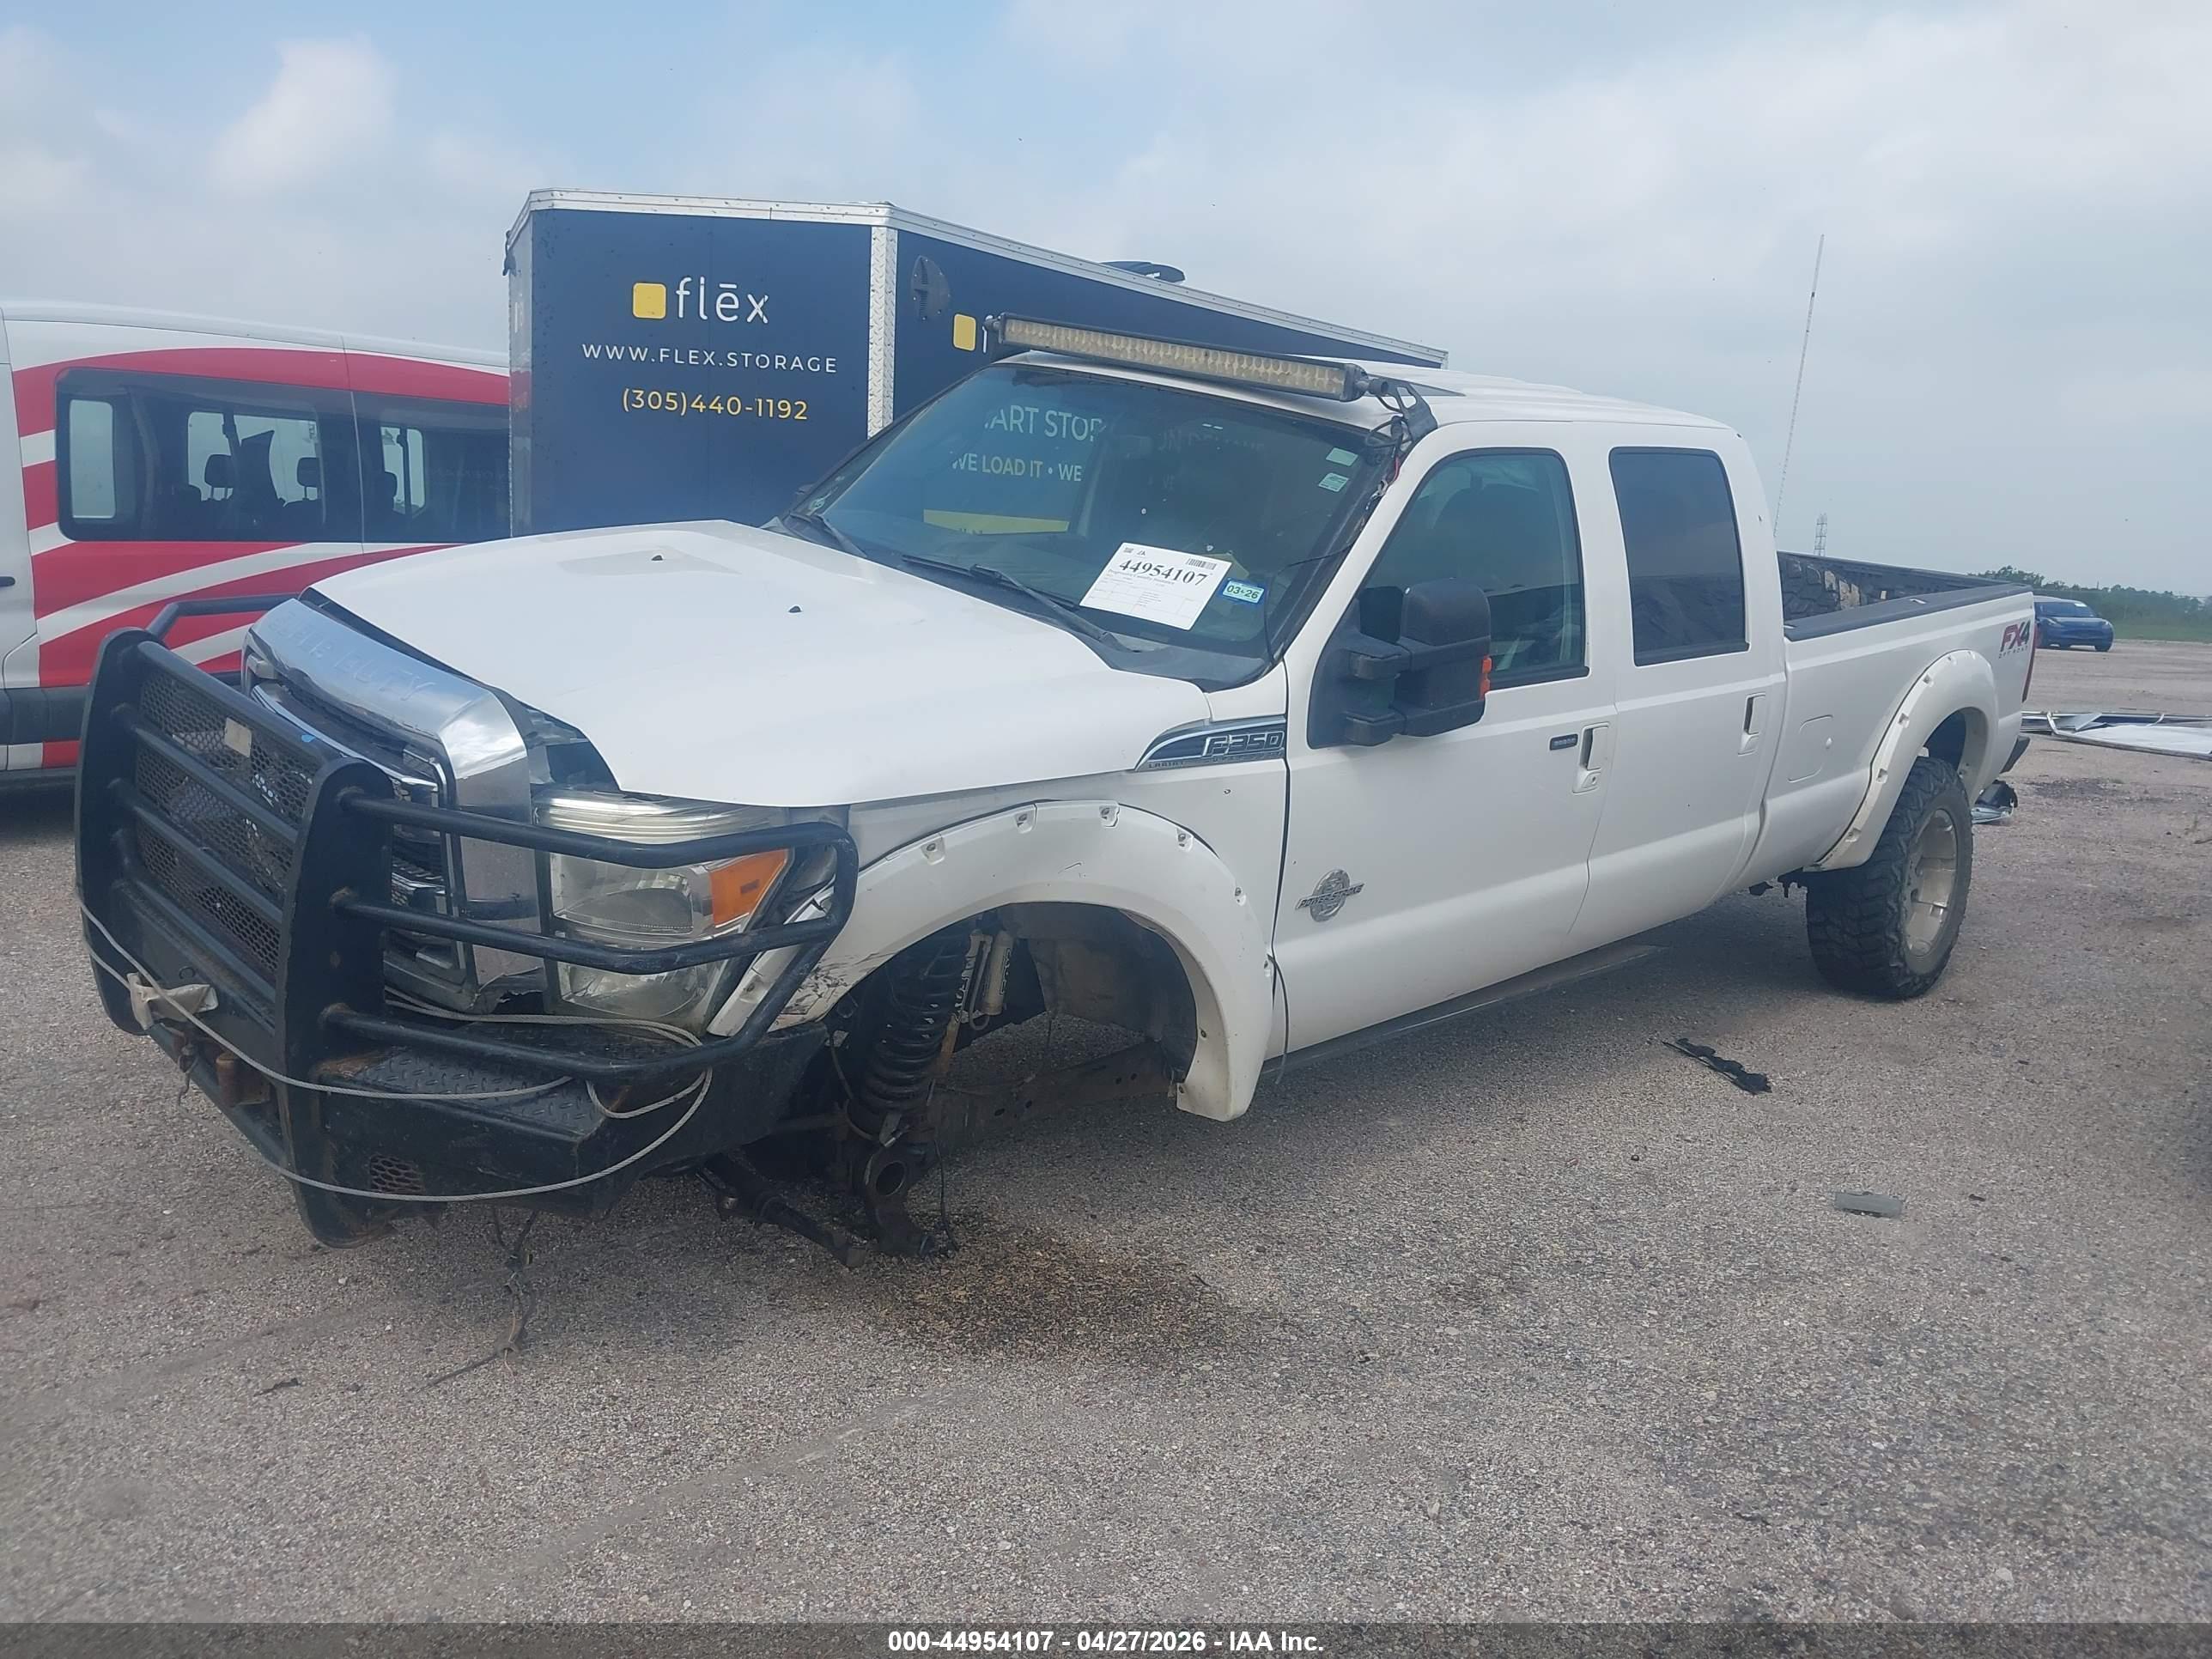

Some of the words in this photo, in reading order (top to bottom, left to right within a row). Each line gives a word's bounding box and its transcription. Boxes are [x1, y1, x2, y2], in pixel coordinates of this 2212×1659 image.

[675, 276, 769, 325] flēx
[581, 343, 838, 374] WWW.FLEX.STORAGE
[622, 388, 809, 420] (305)440-1192
[985, 404, 1040, 434] ART
[981, 454, 1026, 477] LOAD
[1030, 459, 1043, 478] IT
[1058, 463, 1083, 482] WE
[1119, 558, 1209, 586] 44954107
[2000, 619, 2032, 653] FX4
